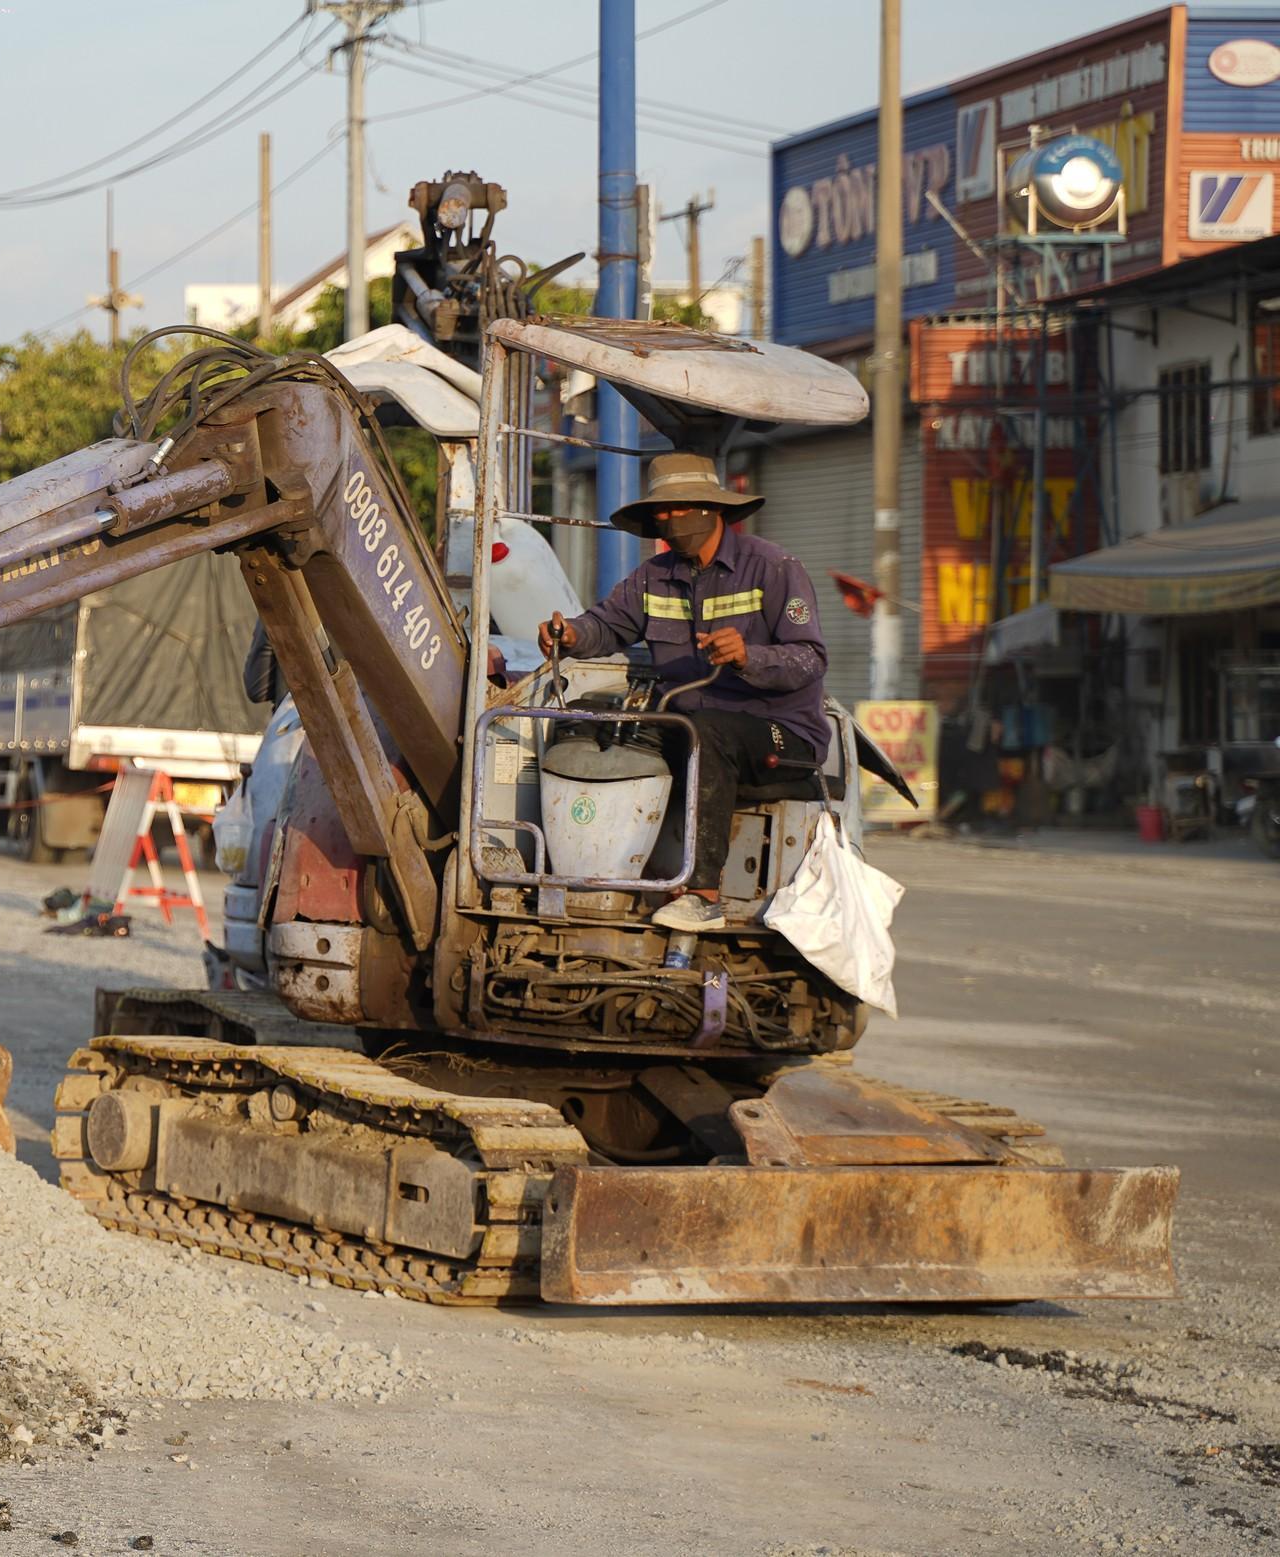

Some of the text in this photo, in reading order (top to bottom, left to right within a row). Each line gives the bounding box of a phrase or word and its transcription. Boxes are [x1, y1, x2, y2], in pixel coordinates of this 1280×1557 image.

[344, 471, 441, 669] 0903 614 403
